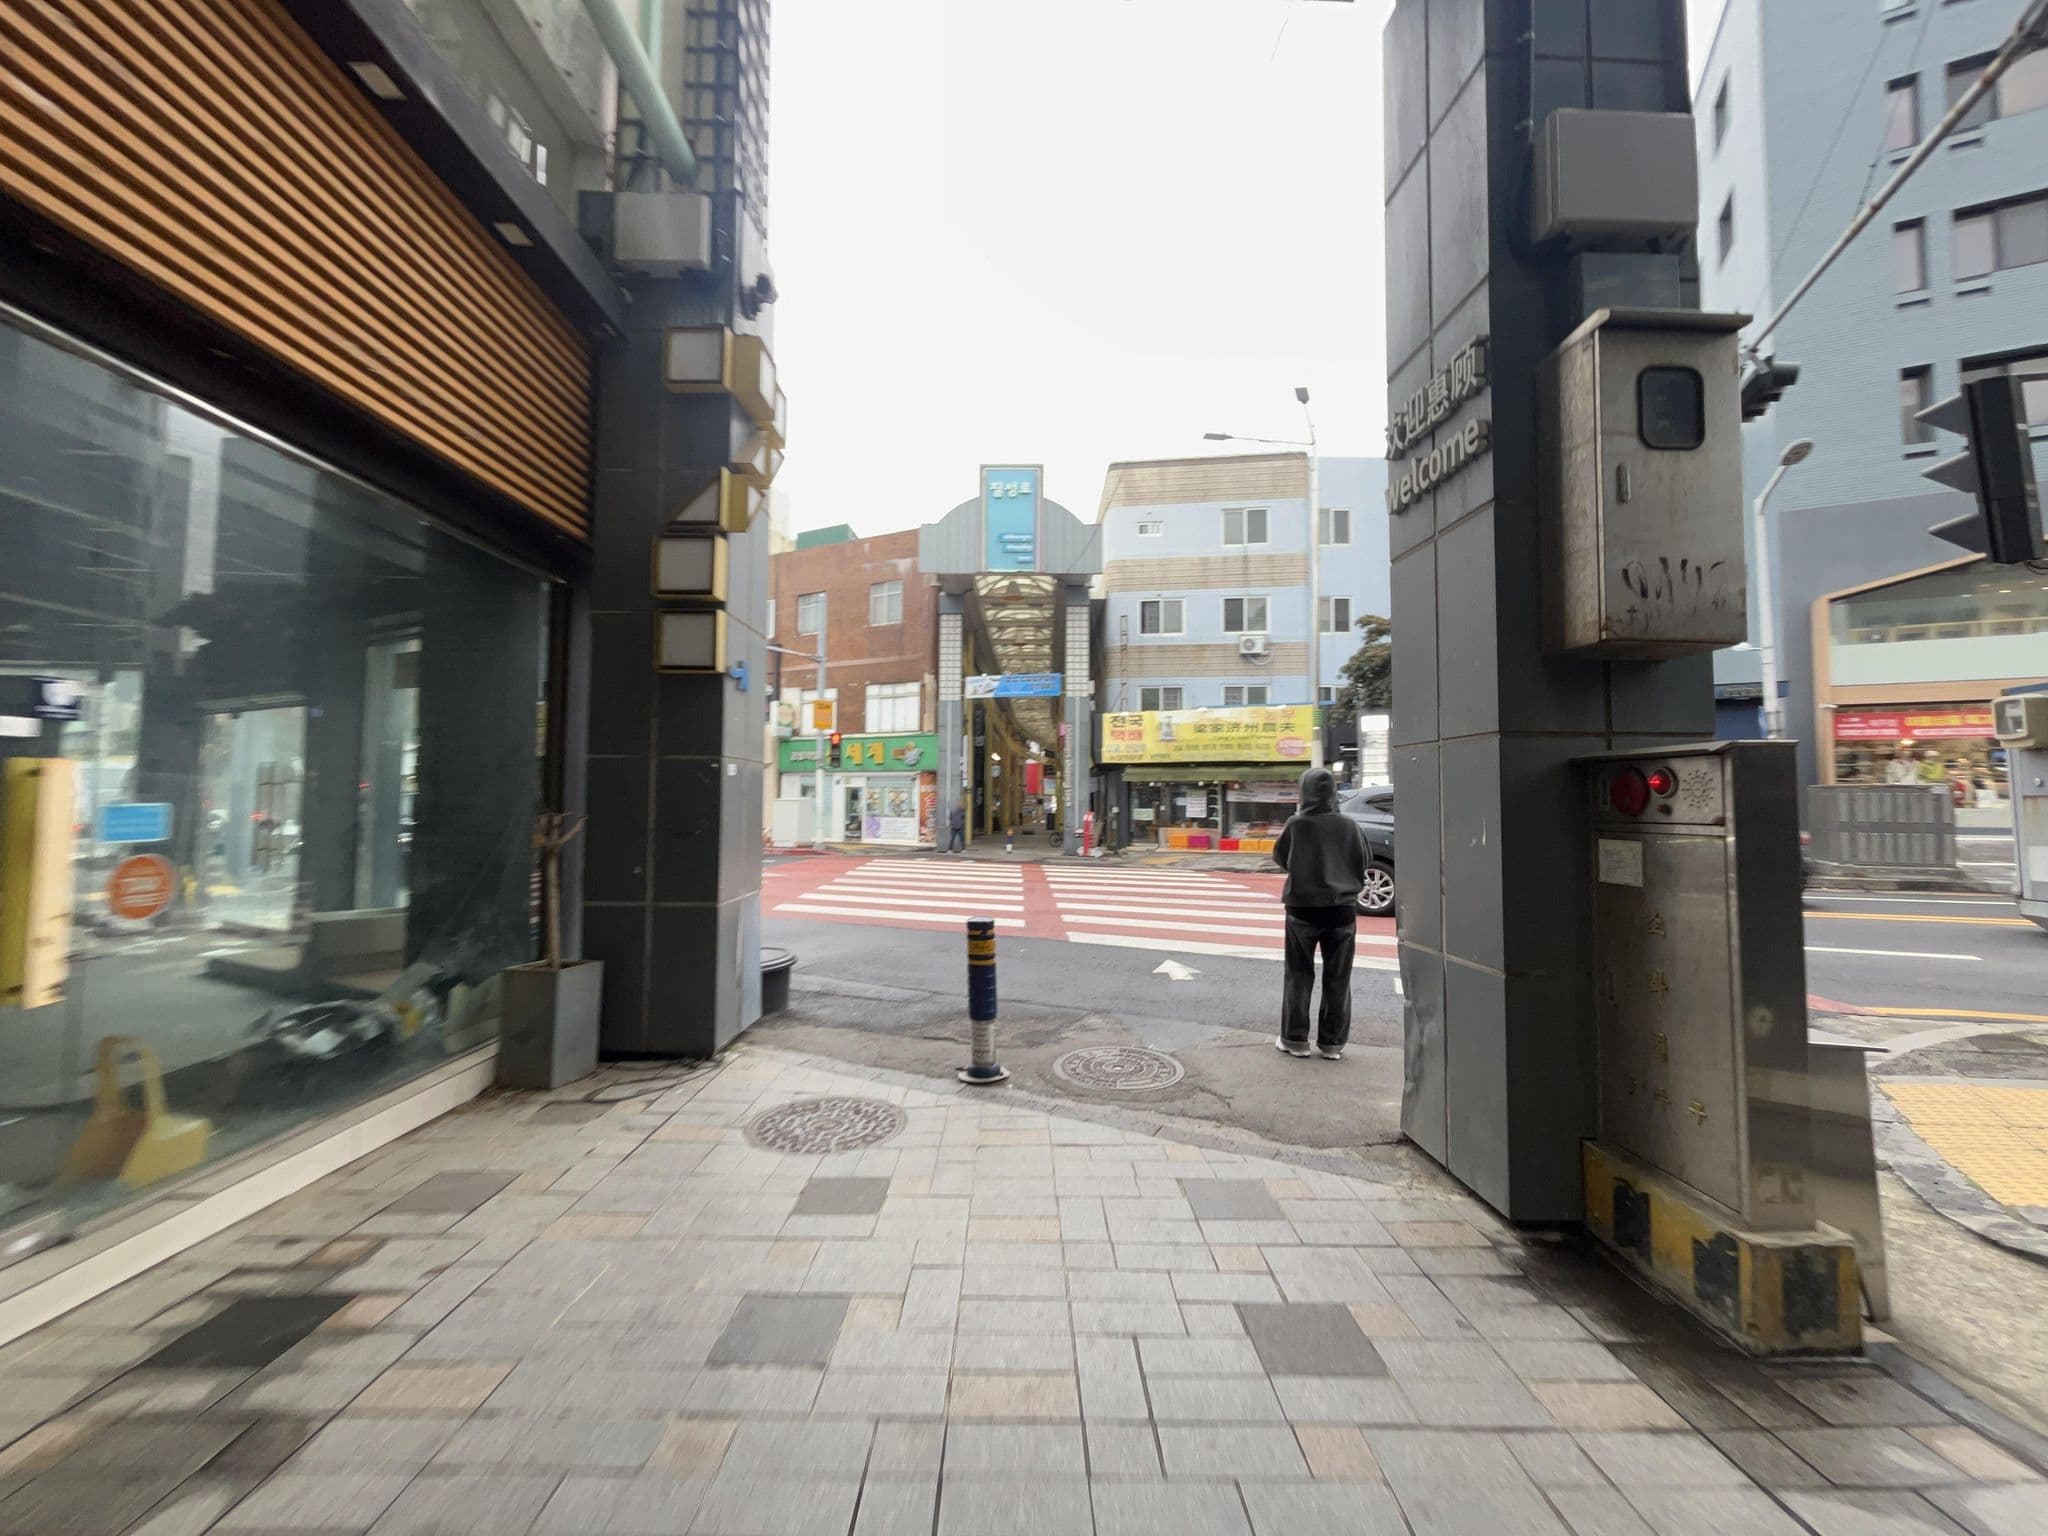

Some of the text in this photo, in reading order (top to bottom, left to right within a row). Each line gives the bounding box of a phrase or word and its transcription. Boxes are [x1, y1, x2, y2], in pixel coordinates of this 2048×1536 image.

[1385, 417, 1485, 515] welcome
[1109, 714, 1143, 728] 전국
[1110, 729, 1143, 742] 택배
